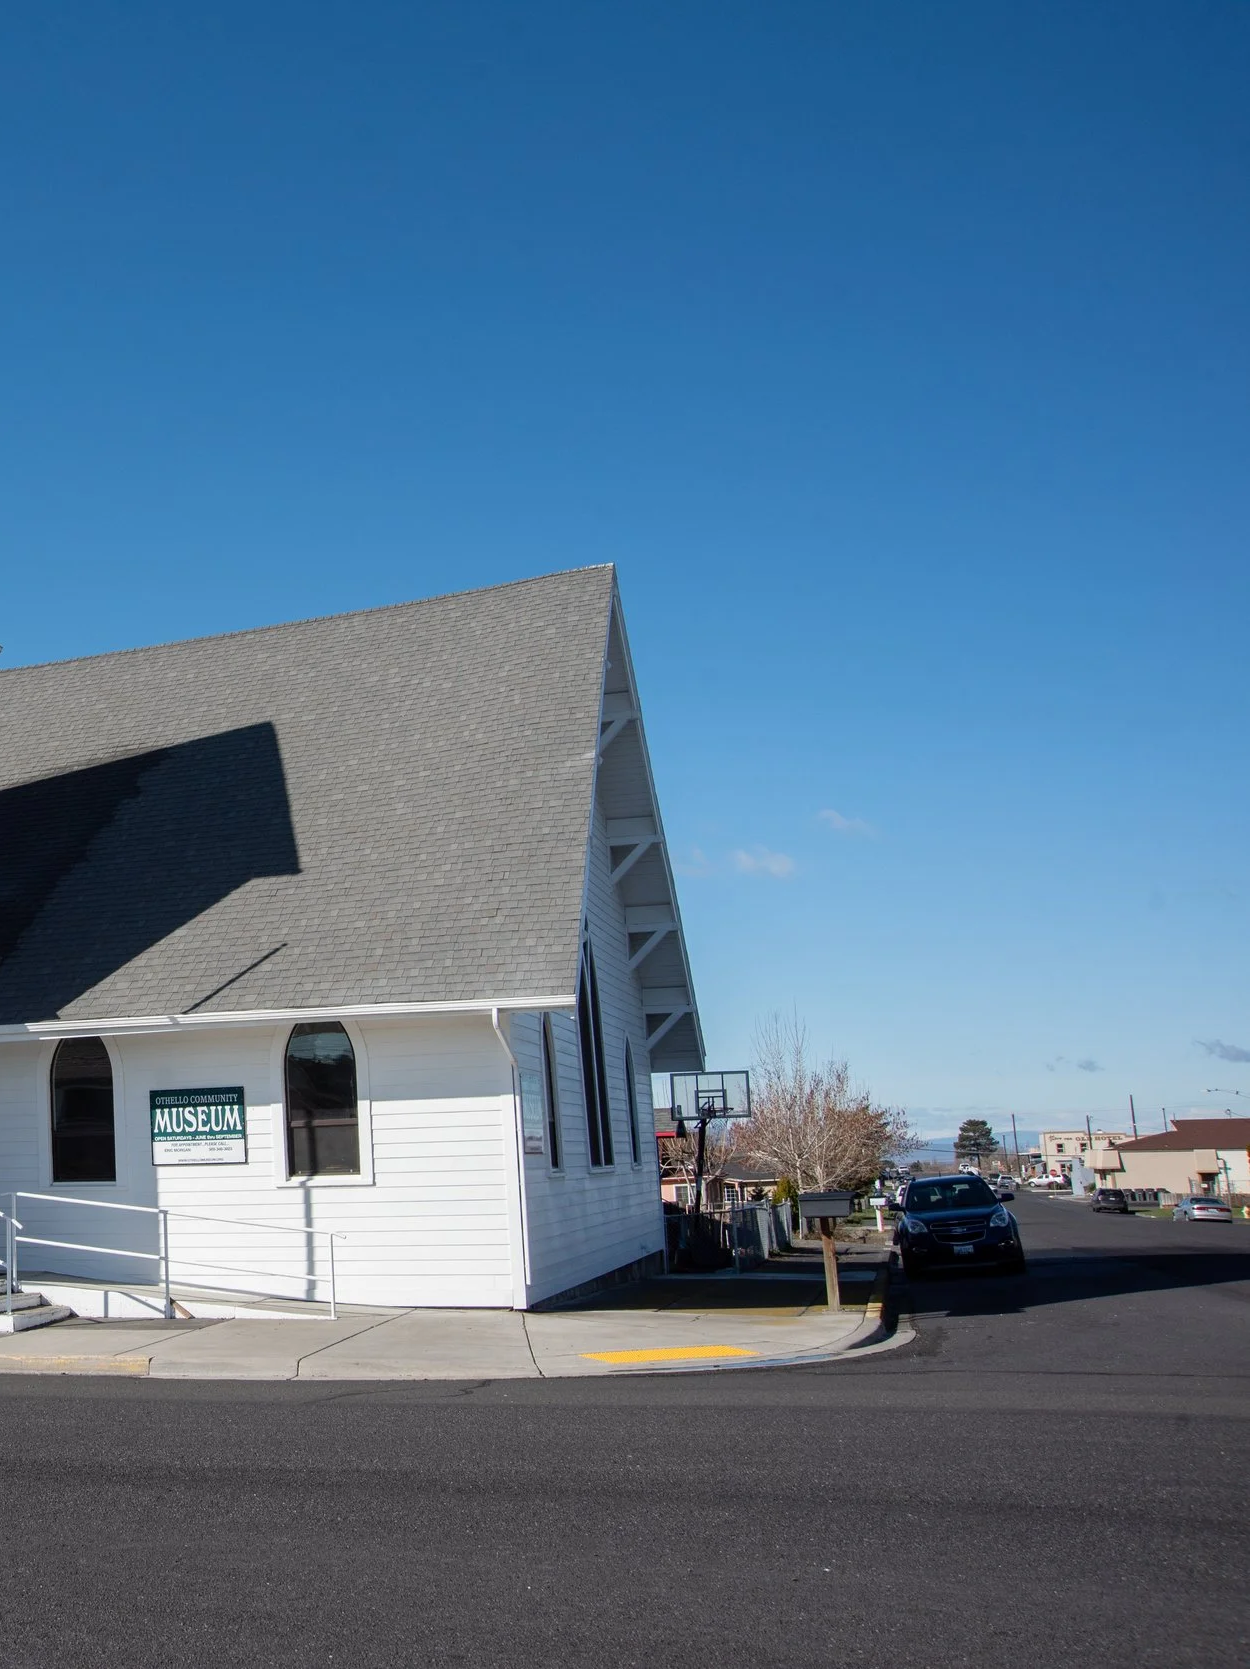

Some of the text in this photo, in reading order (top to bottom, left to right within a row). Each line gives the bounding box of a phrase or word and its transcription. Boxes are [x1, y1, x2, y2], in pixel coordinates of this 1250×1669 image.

[155, 1094, 238, 1105] OTHELLO COMMUNITY
[153, 1105, 242, 1133] MUSEUM
